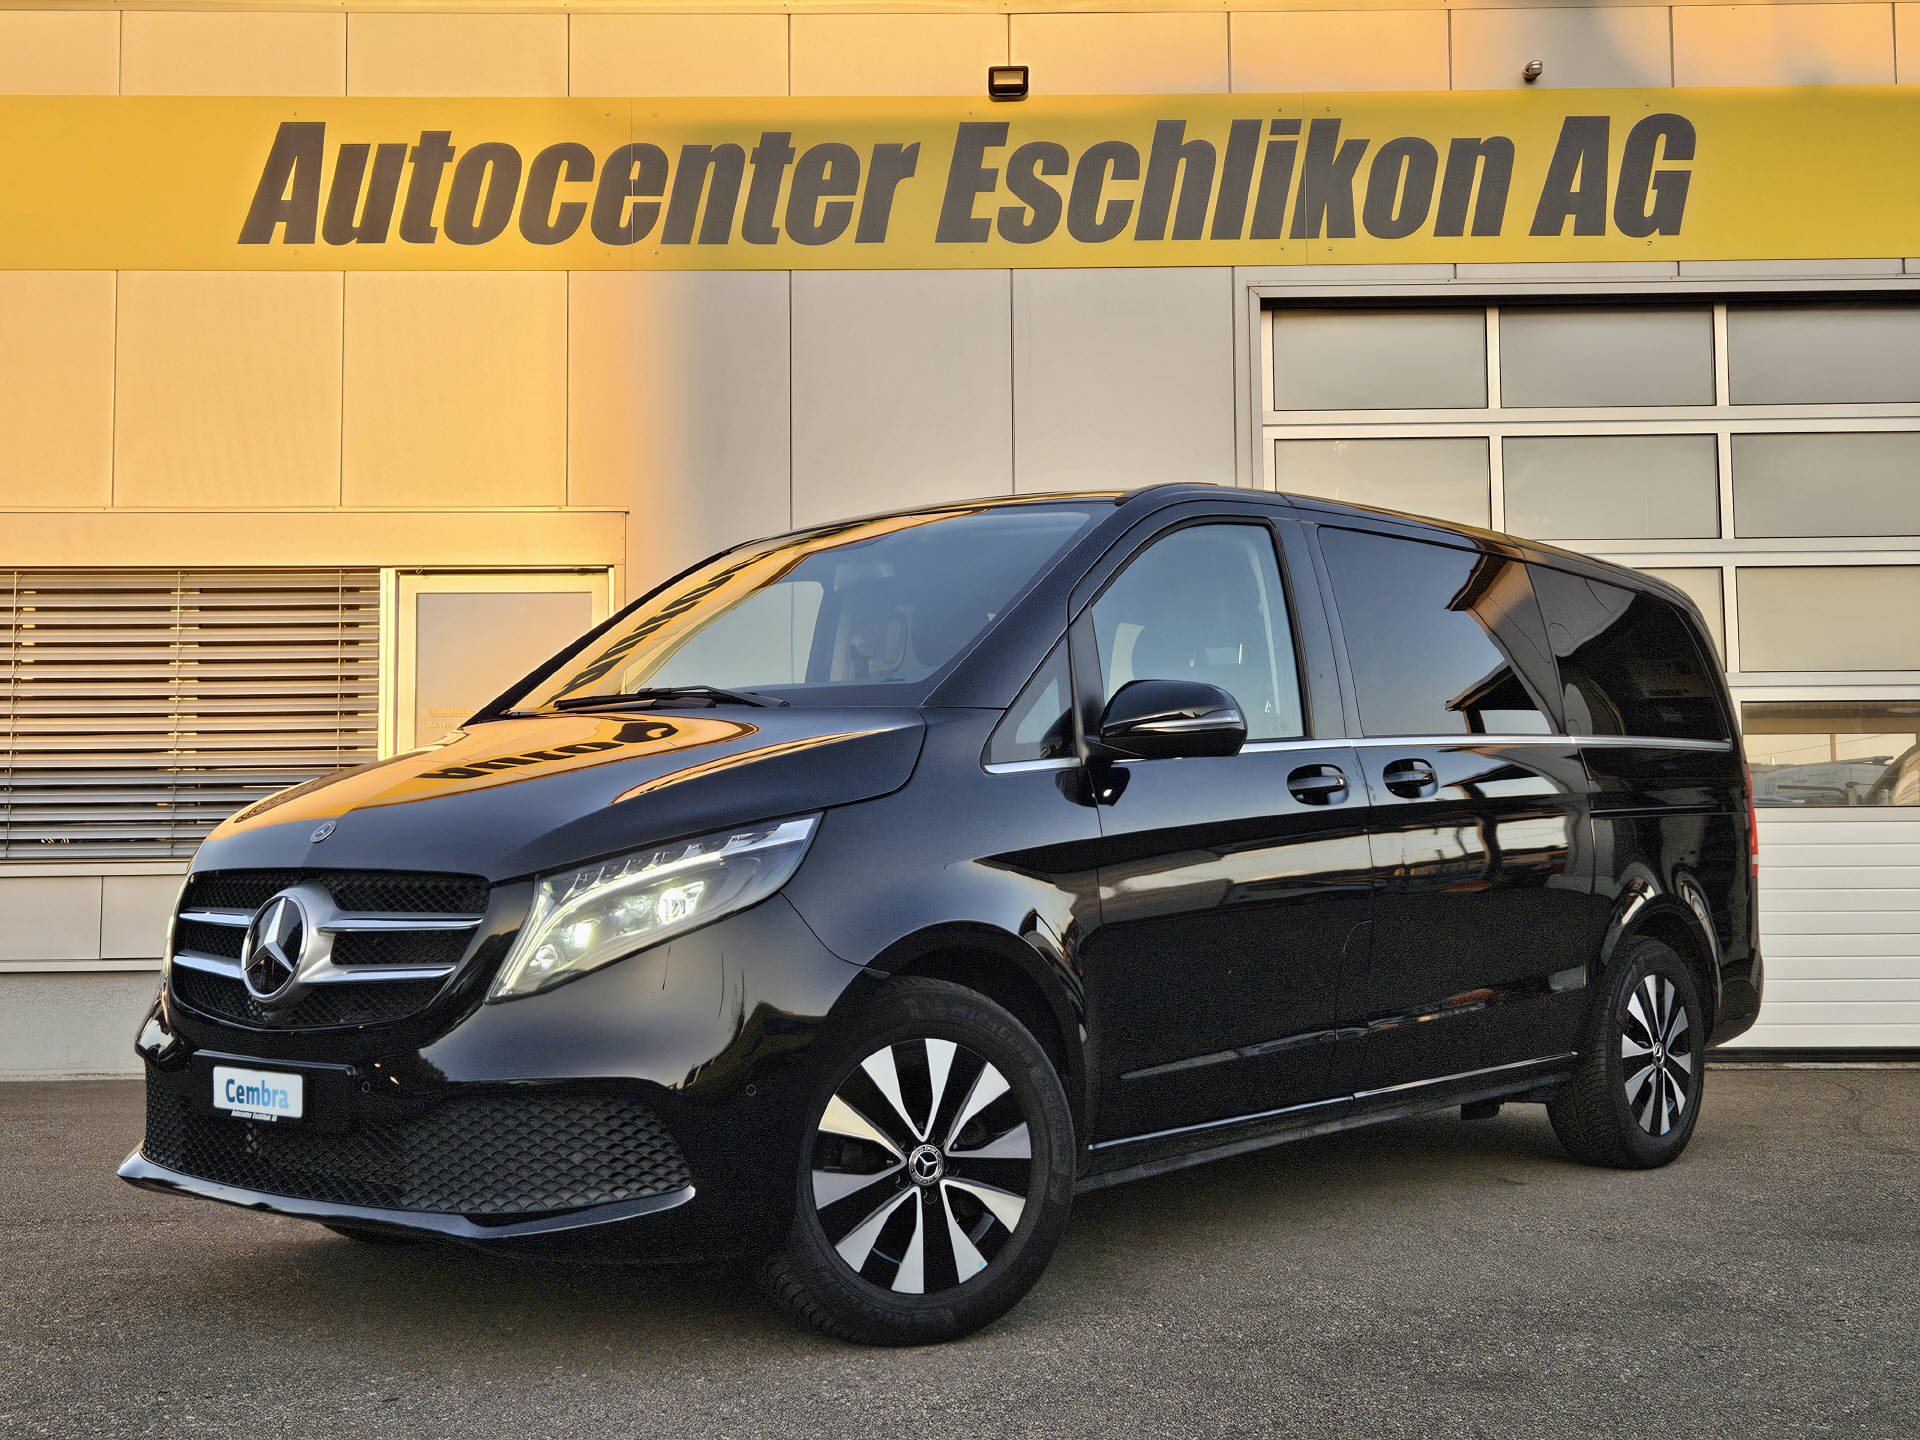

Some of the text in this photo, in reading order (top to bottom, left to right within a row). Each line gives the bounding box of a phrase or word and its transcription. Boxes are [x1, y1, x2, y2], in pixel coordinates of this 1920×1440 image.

[237, 112, 1697, 246] Autocenter Eschlikon AG
[225, 1078, 290, 1110] Cembra
